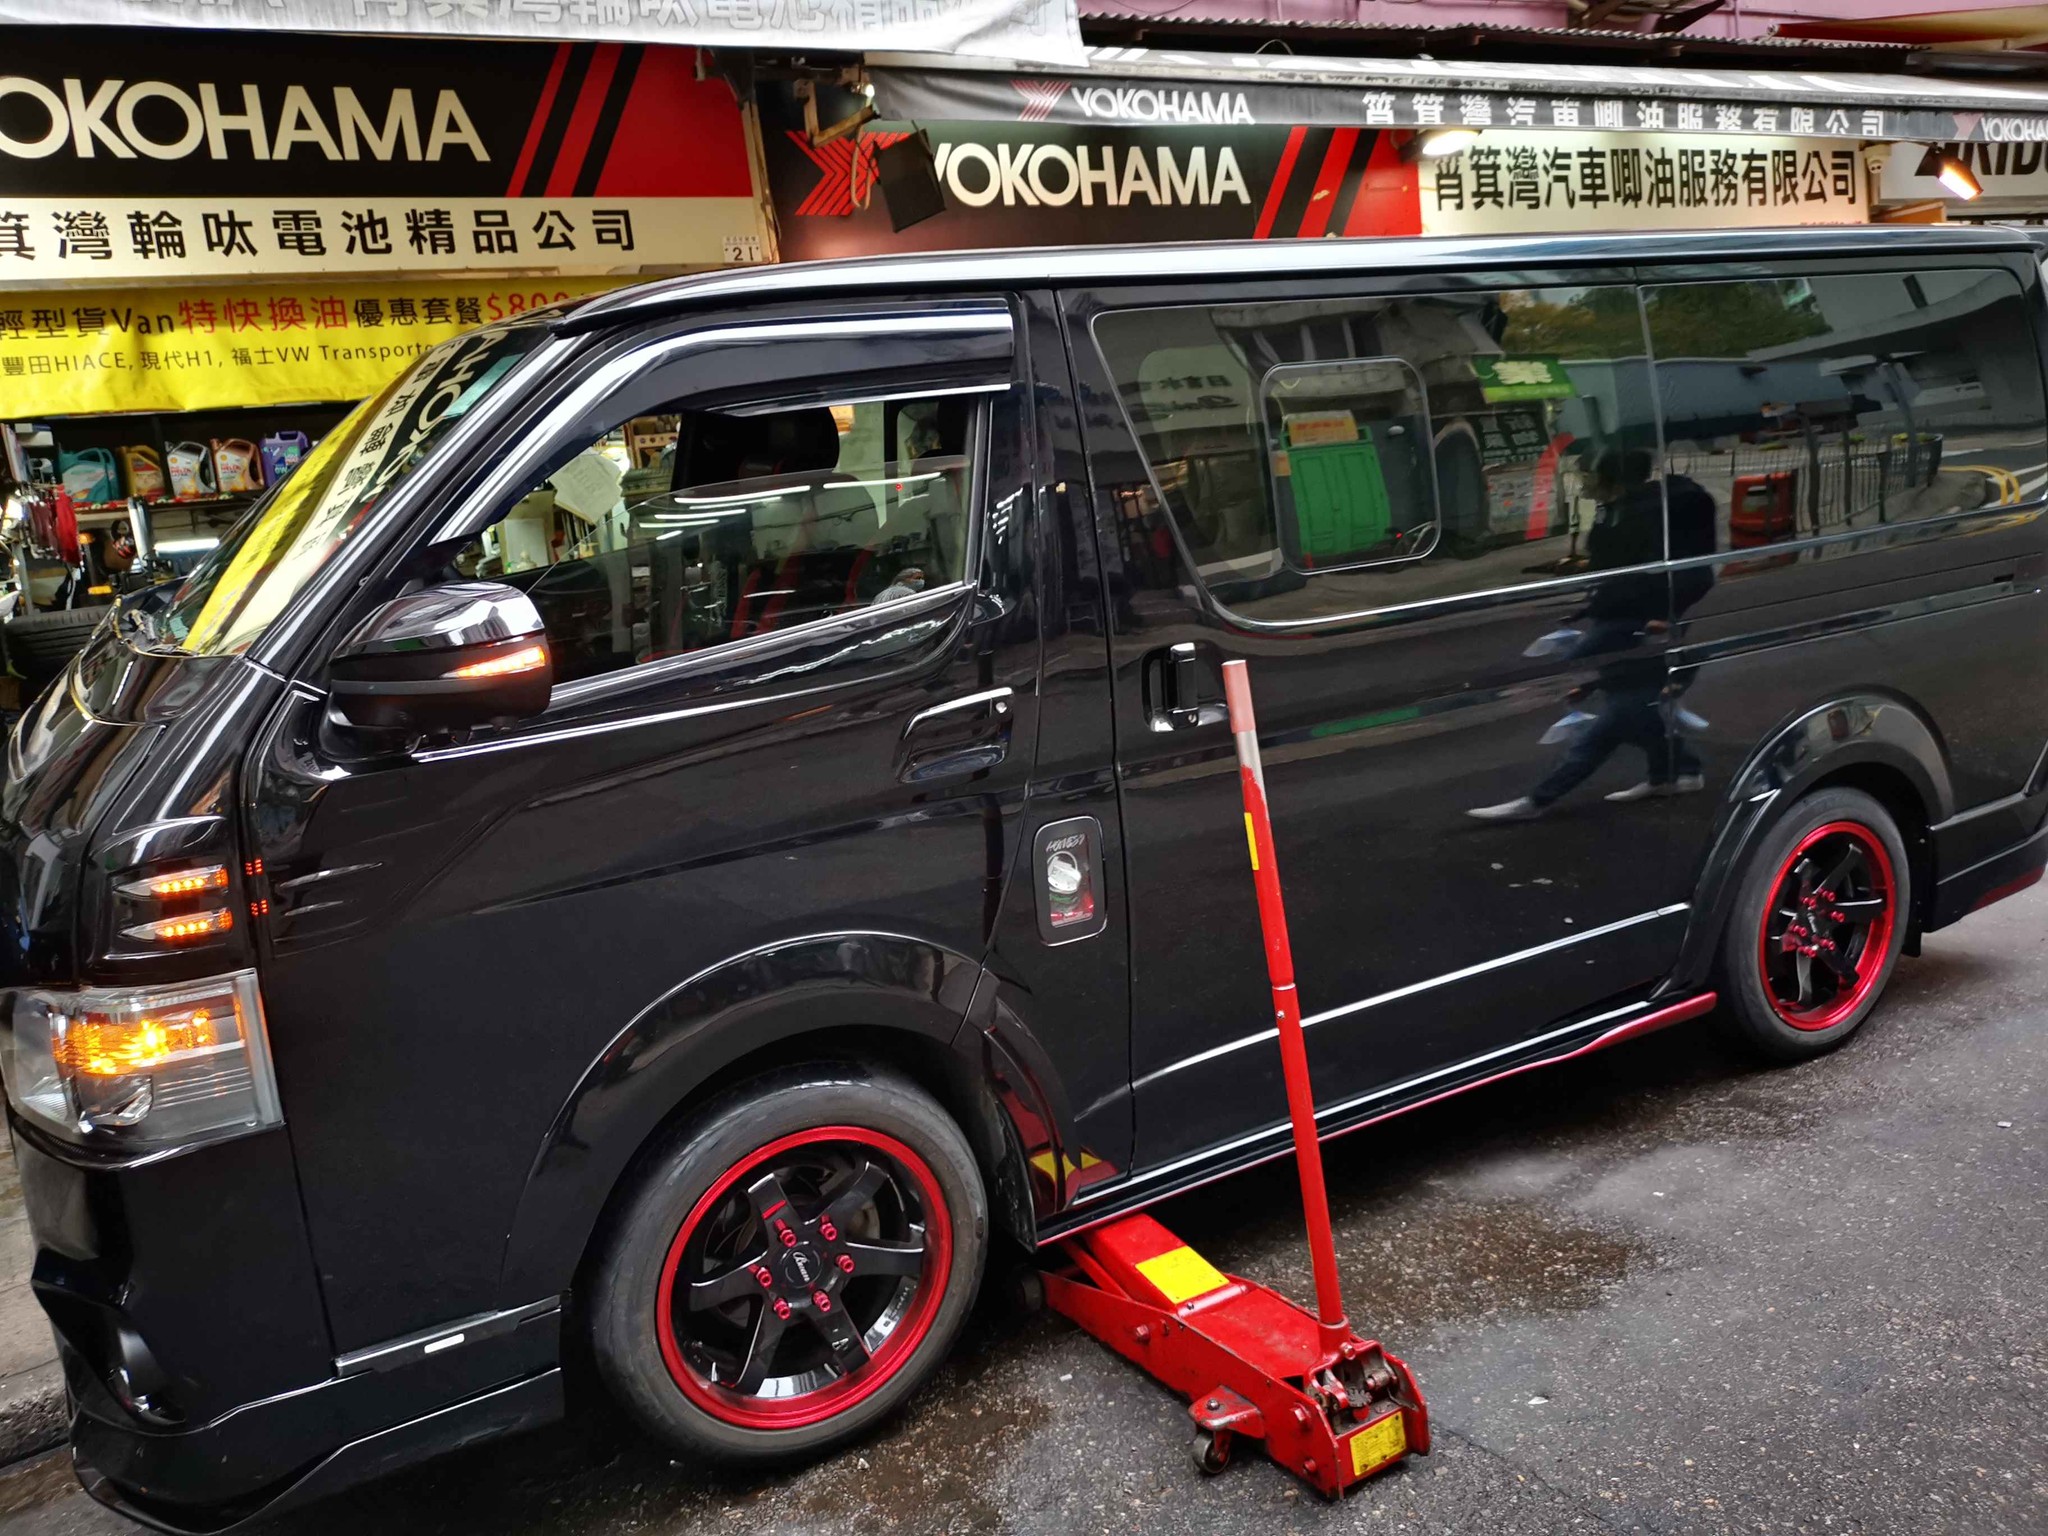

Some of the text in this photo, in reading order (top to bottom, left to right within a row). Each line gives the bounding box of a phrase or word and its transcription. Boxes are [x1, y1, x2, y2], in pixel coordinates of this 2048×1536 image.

[1071, 87, 1255, 125] YOKOHAMA
[1981, 117, 2048, 141] YOKOHA
[732, 246, 754, 261] 21
